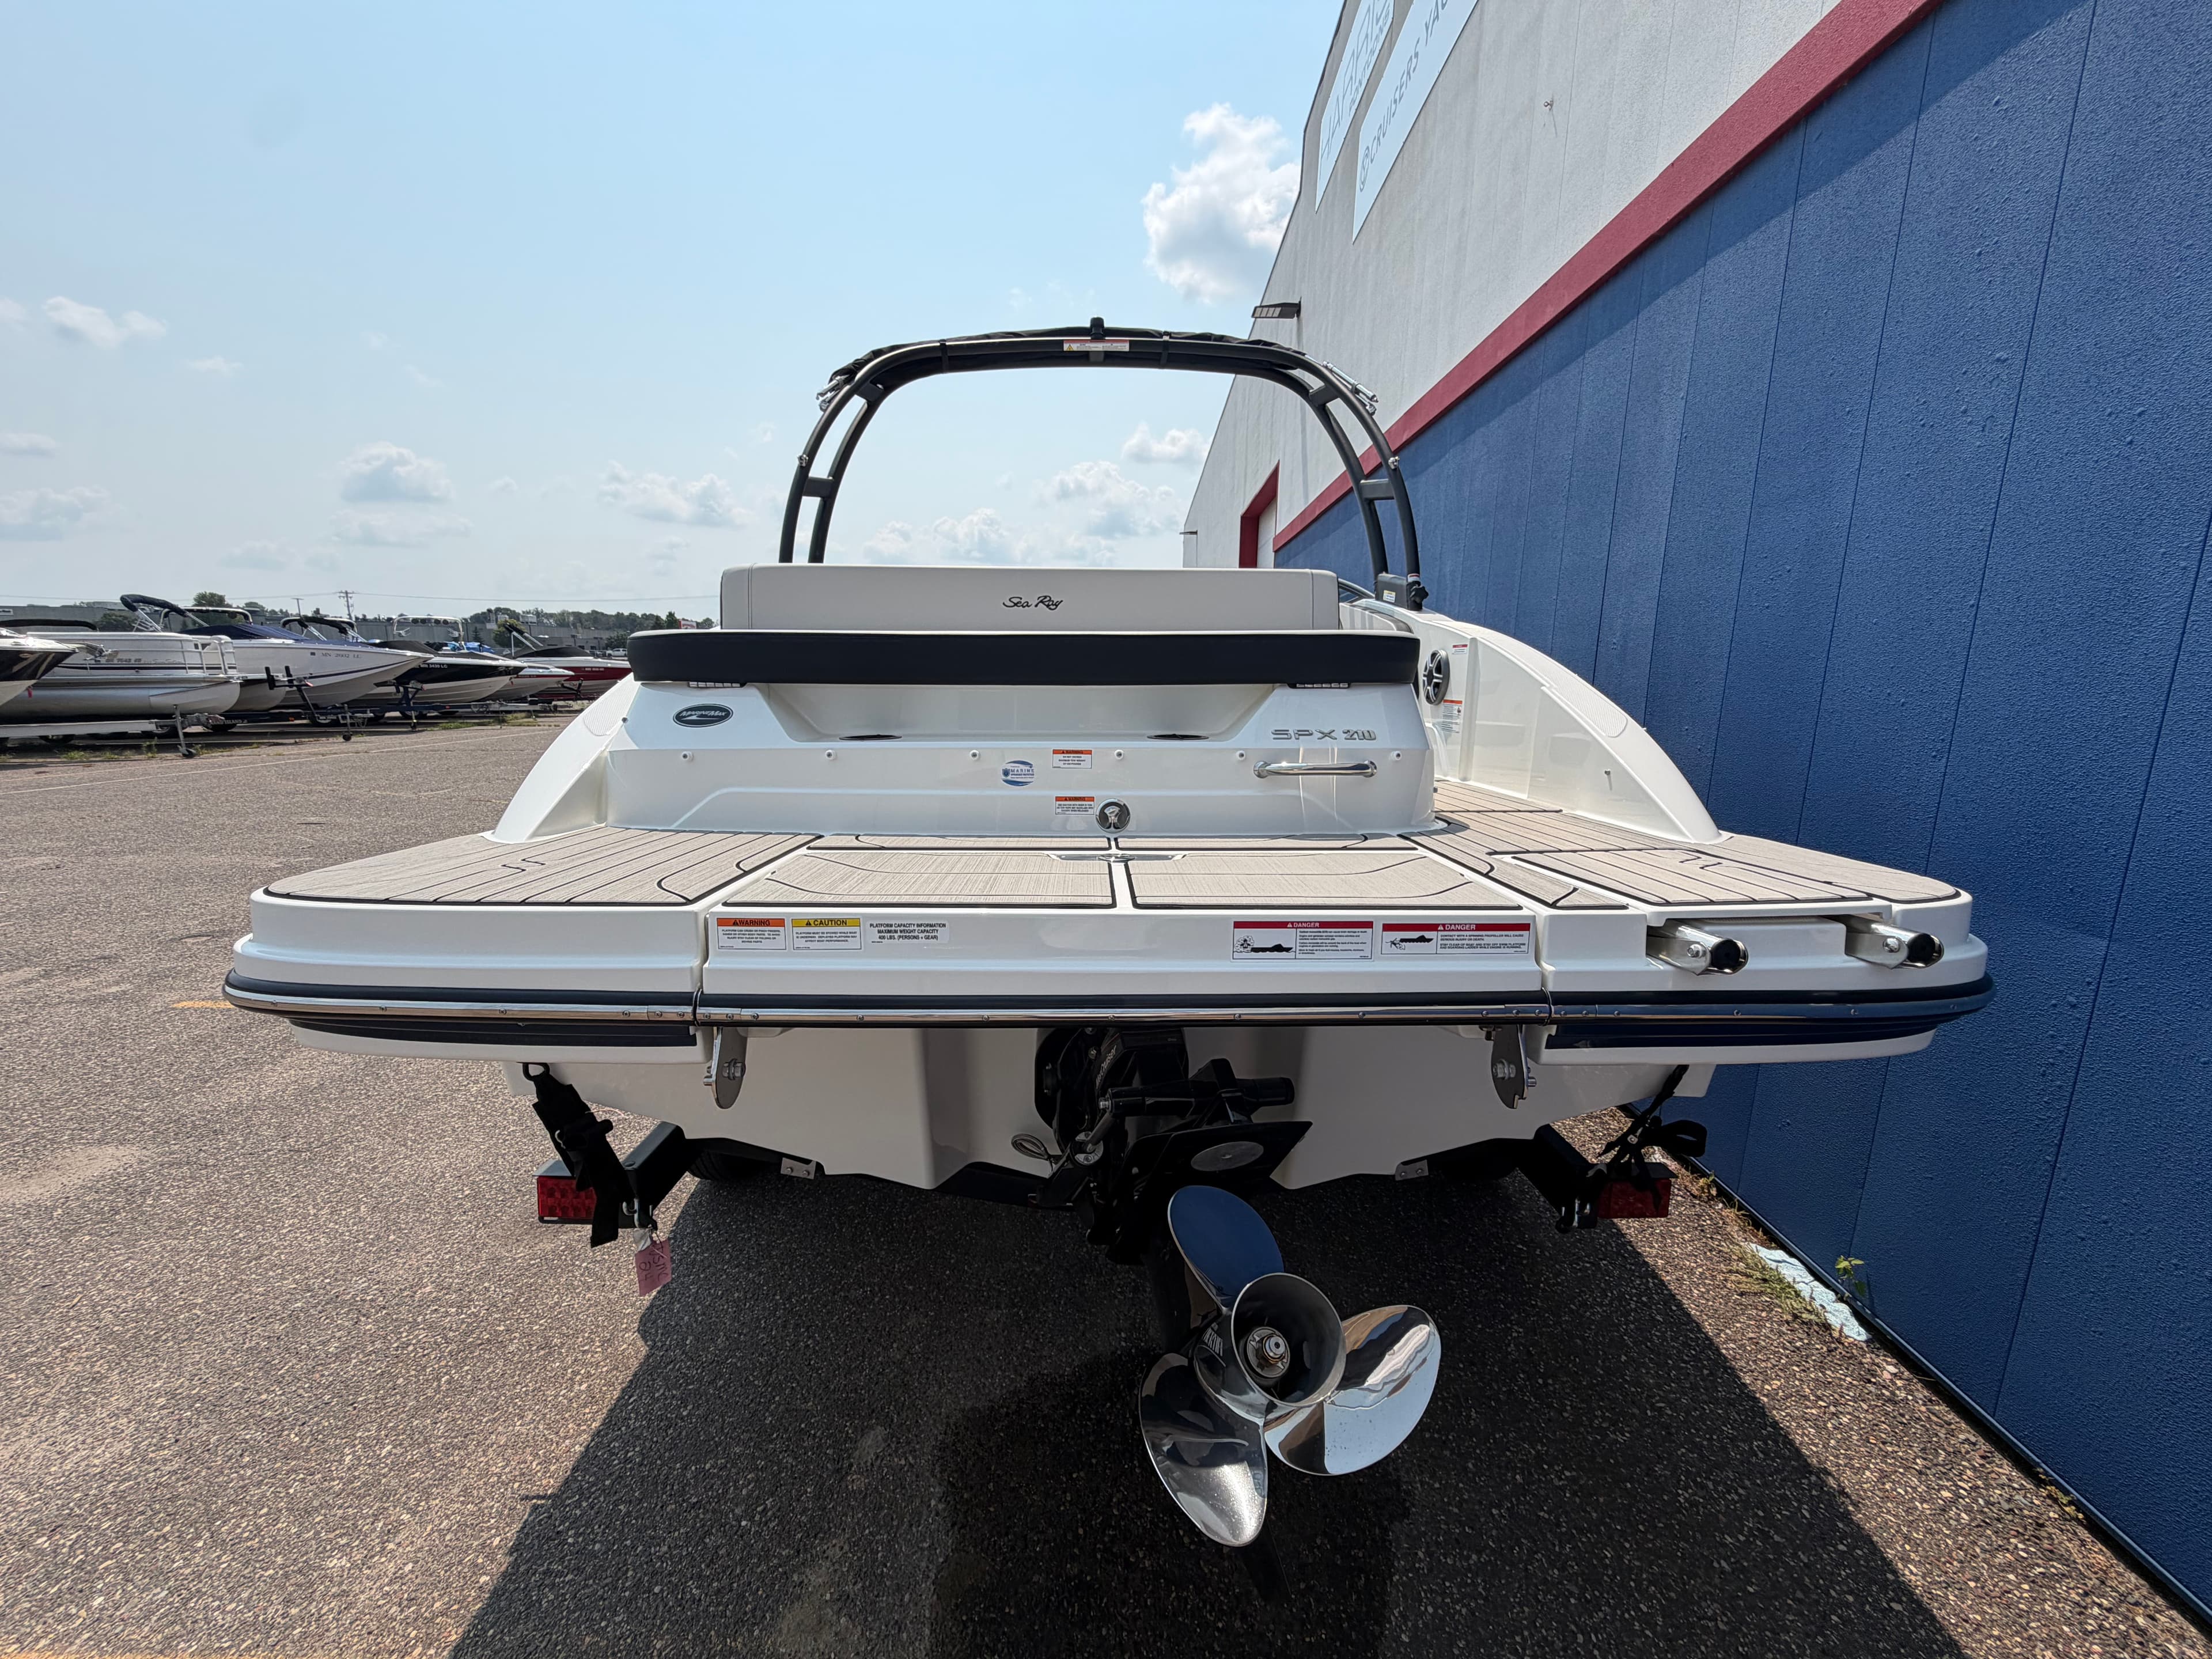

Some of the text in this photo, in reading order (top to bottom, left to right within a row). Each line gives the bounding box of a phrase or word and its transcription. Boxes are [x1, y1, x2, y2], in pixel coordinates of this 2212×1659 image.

[1349, 3, 1390, 118] PONTOONS
[1370, 36, 1420, 165] CRUISERS
[1002, 595, 1063, 611] Sea Ray
[1271, 729, 1376, 741] SPX 210
